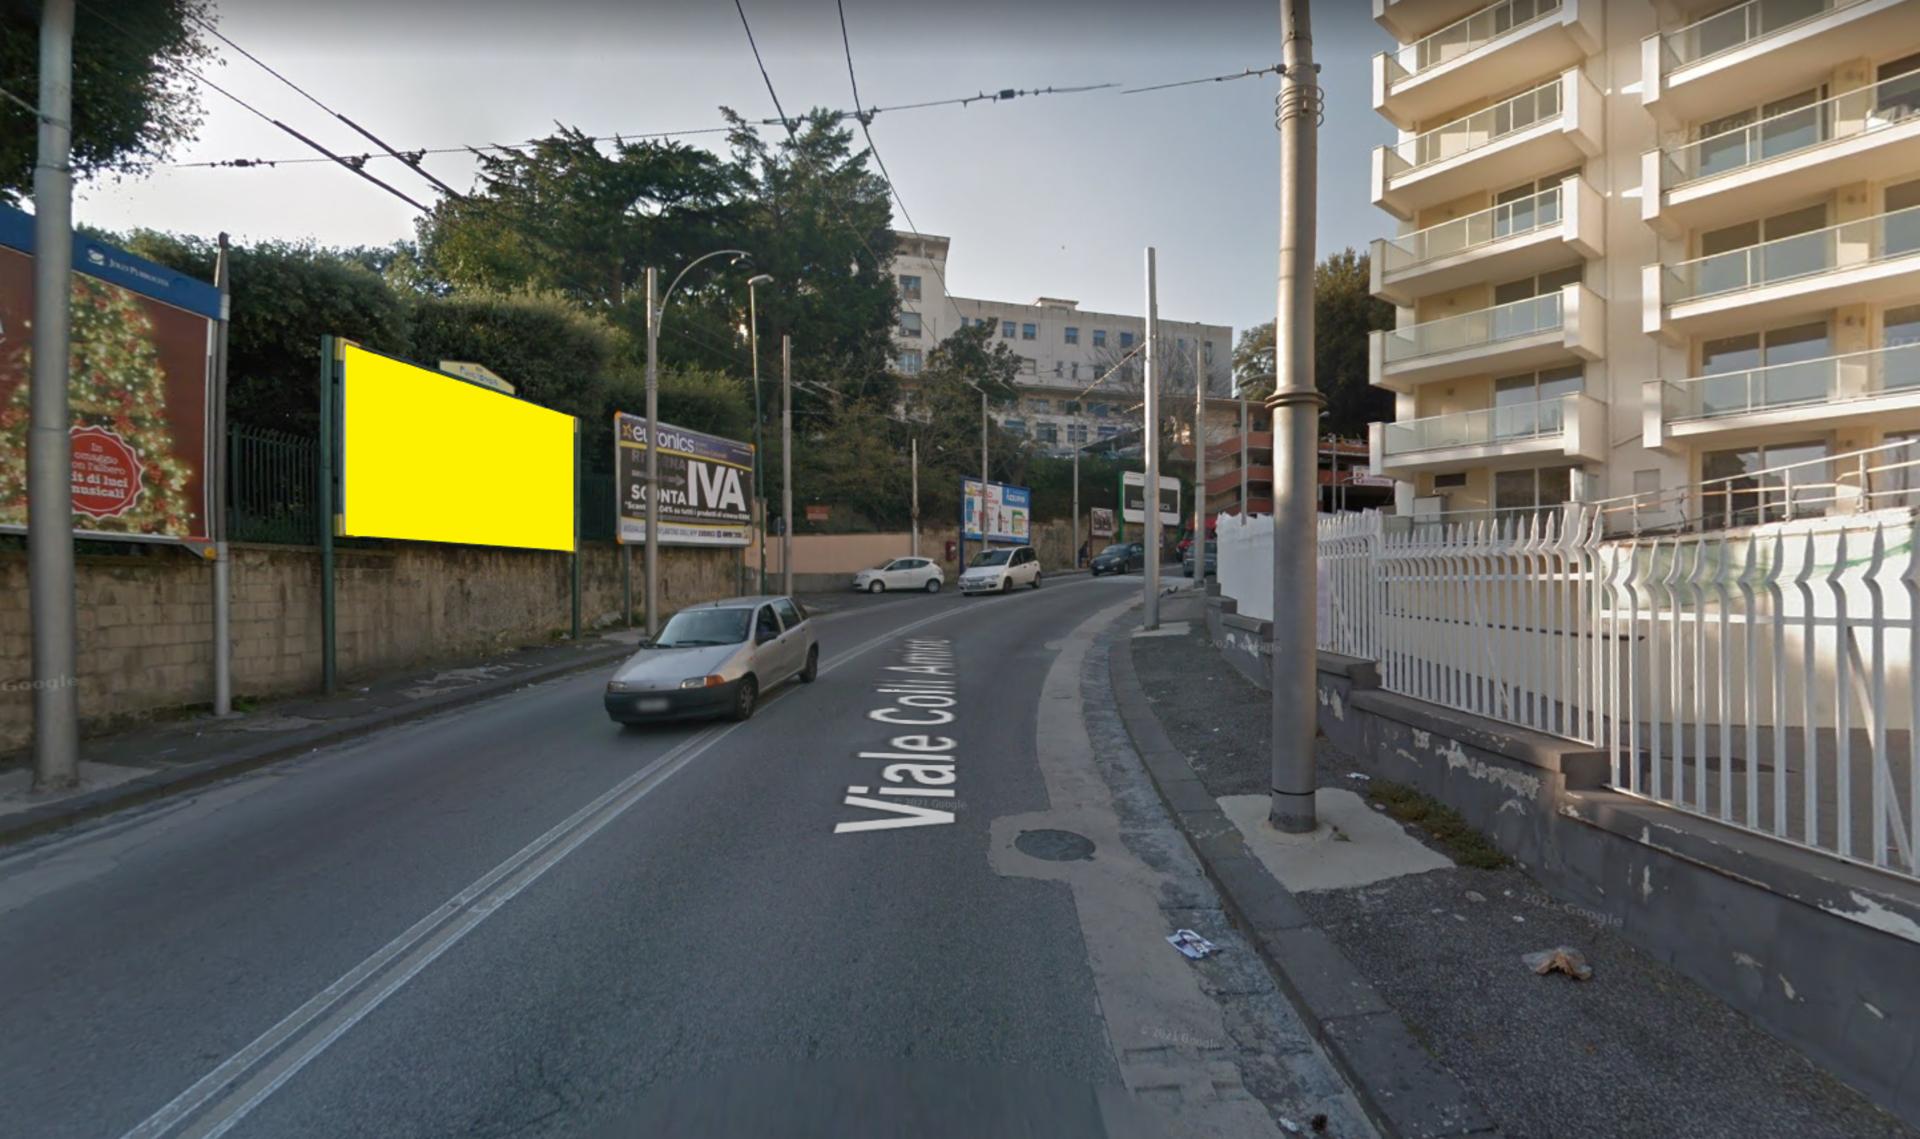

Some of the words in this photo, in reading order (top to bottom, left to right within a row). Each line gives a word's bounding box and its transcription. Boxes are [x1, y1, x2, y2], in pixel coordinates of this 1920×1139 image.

[72, 461, 85, 470] on
[71, 470, 84, 482] it
[87, 474, 100, 484] di
[103, 475, 128, 488] luci
